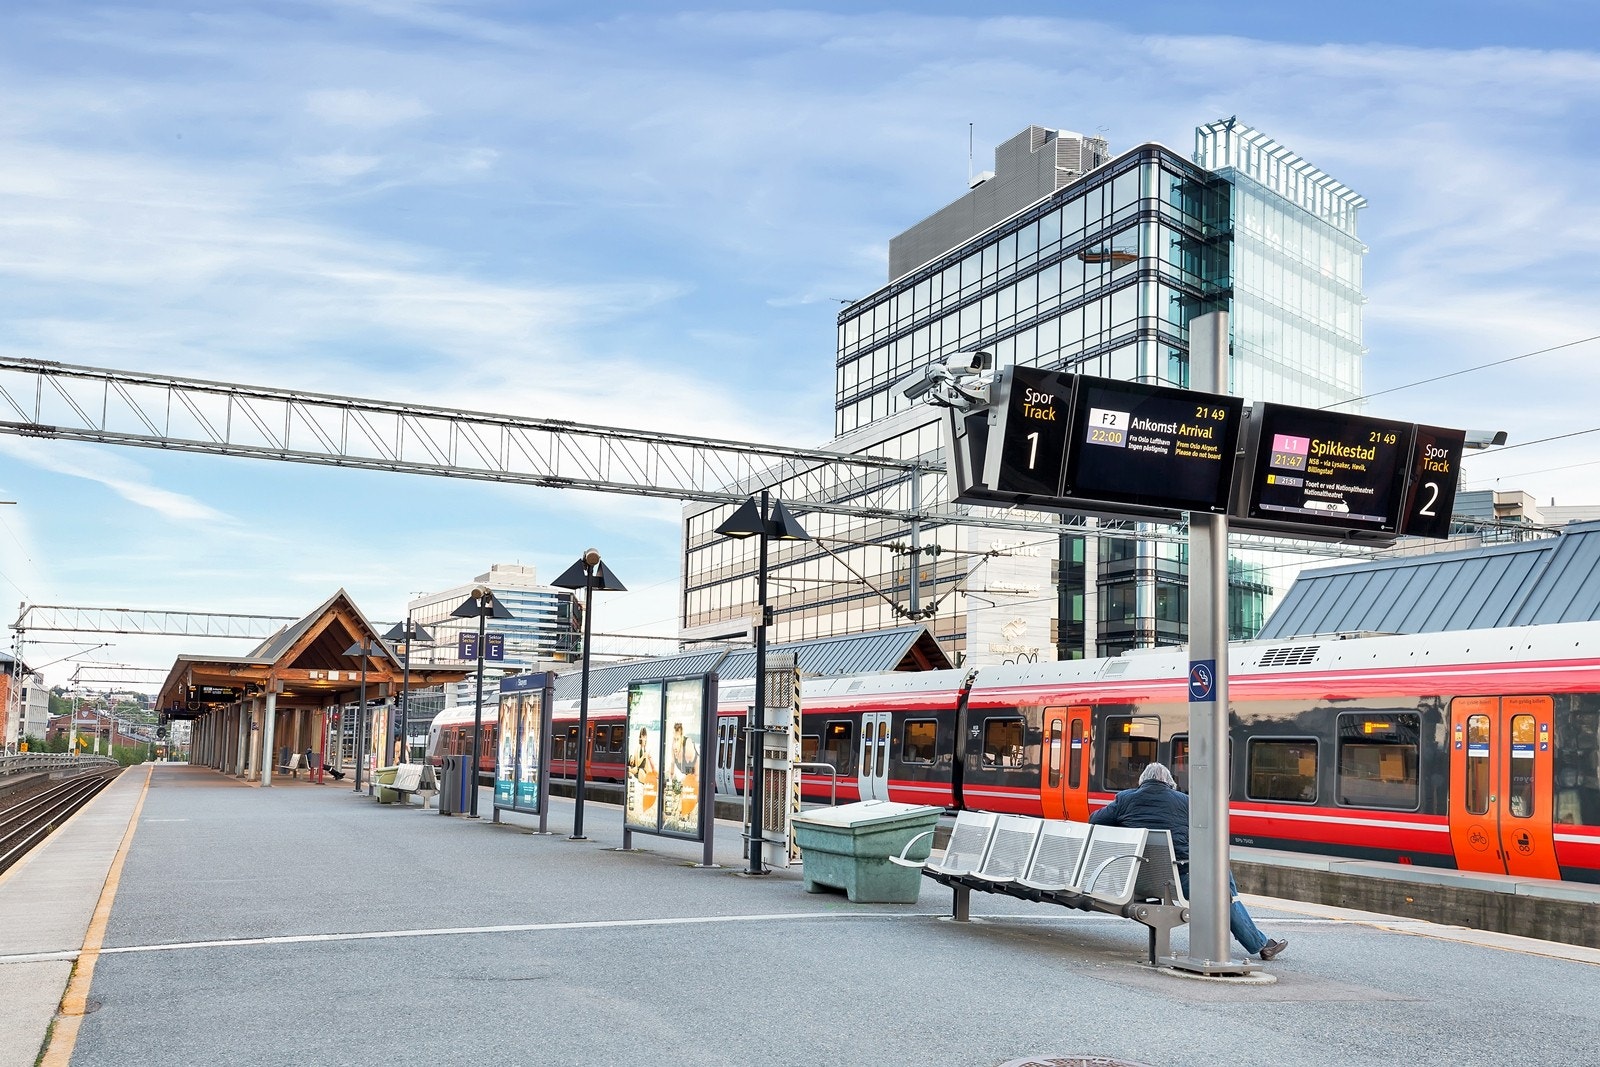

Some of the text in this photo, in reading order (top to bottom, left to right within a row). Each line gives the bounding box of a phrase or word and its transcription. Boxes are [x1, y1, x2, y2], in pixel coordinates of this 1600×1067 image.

[1024, 388, 1054, 405] Spor
[1023, 403, 1056, 420] Track
[1195, 406, 1225, 421] 21 49
[1131, 417, 1213, 439] Ankomst Arrival
[1091, 429, 1122, 444] 22:00
[1129, 434, 1138, 442] Fra
[1150, 436, 1171, 446] Lufthavn
[1369, 431, 1396, 445] 21 49
[1027, 432, 1039, 469] 1
[1128, 442, 1168, 455] Ingen påstigning
[1177, 440, 1218, 452] From Oslo Airport
[1311, 439, 1376, 460] Spikkestad
[1425, 443, 1449, 460] Spor
[1176, 448, 1192, 457] Please
[1192, 450, 1199, 458] do
[1207, 452, 1222, 460] board
[1274, 454, 1303, 467] 21:47
[1308, 457, 1320, 466] NSB
[1423, 457, 1450, 473] Track
[1307, 465, 1334, 475] Billingstad
[1281, 478, 1297, 486] 21:51
[1419, 482, 1439, 517] 2
[465, 644, 473, 656] E
[491, 645, 498, 657] E
